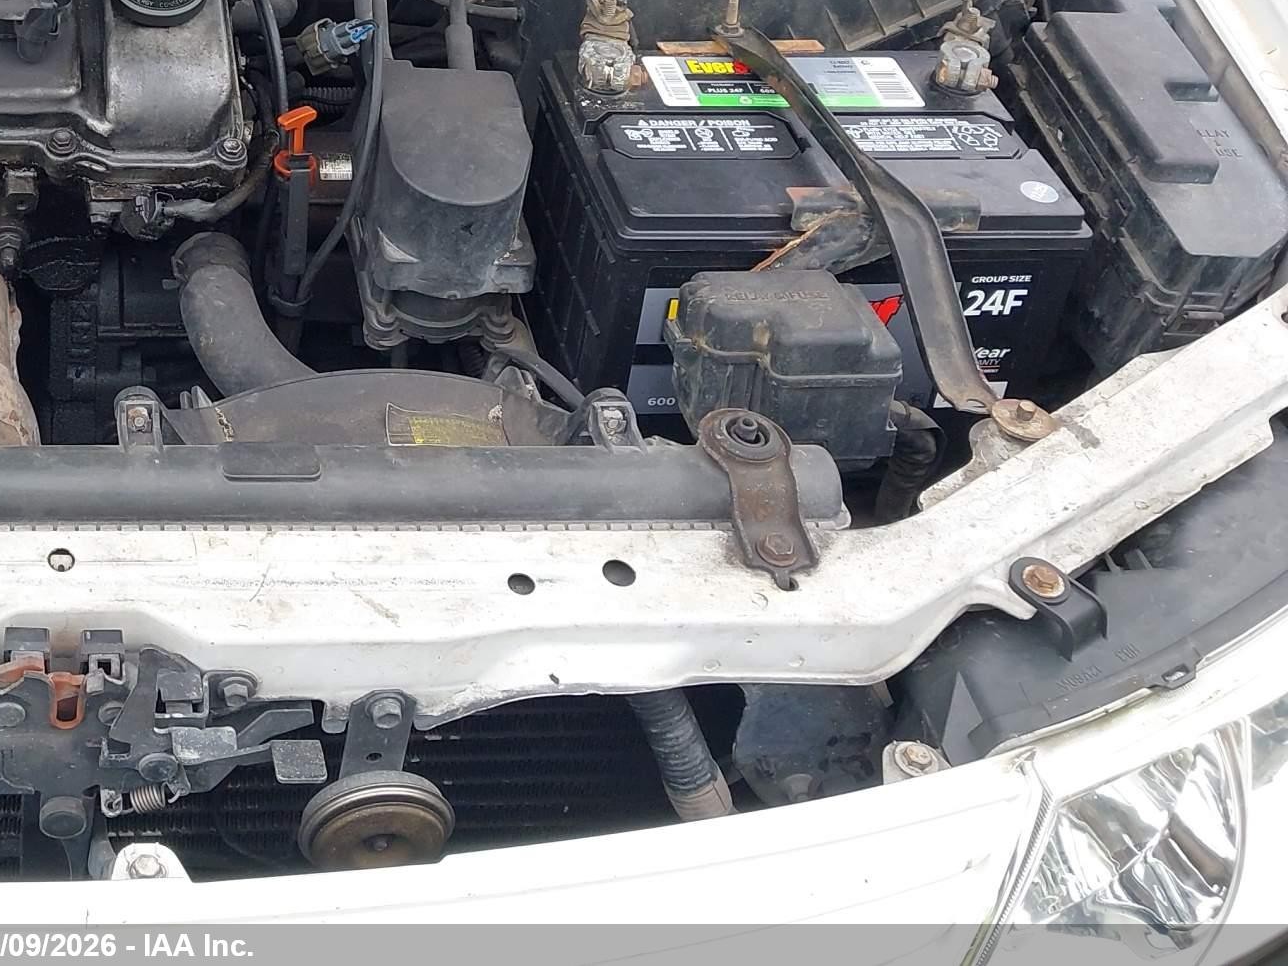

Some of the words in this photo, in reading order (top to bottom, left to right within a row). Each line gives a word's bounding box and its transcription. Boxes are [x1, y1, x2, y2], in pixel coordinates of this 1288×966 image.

[971, 276, 1008, 284] GROUP
[1010, 275, 1033, 283] SIZE
[963, 289, 1028, 316] 24F
[647, 396, 677, 407] 600
